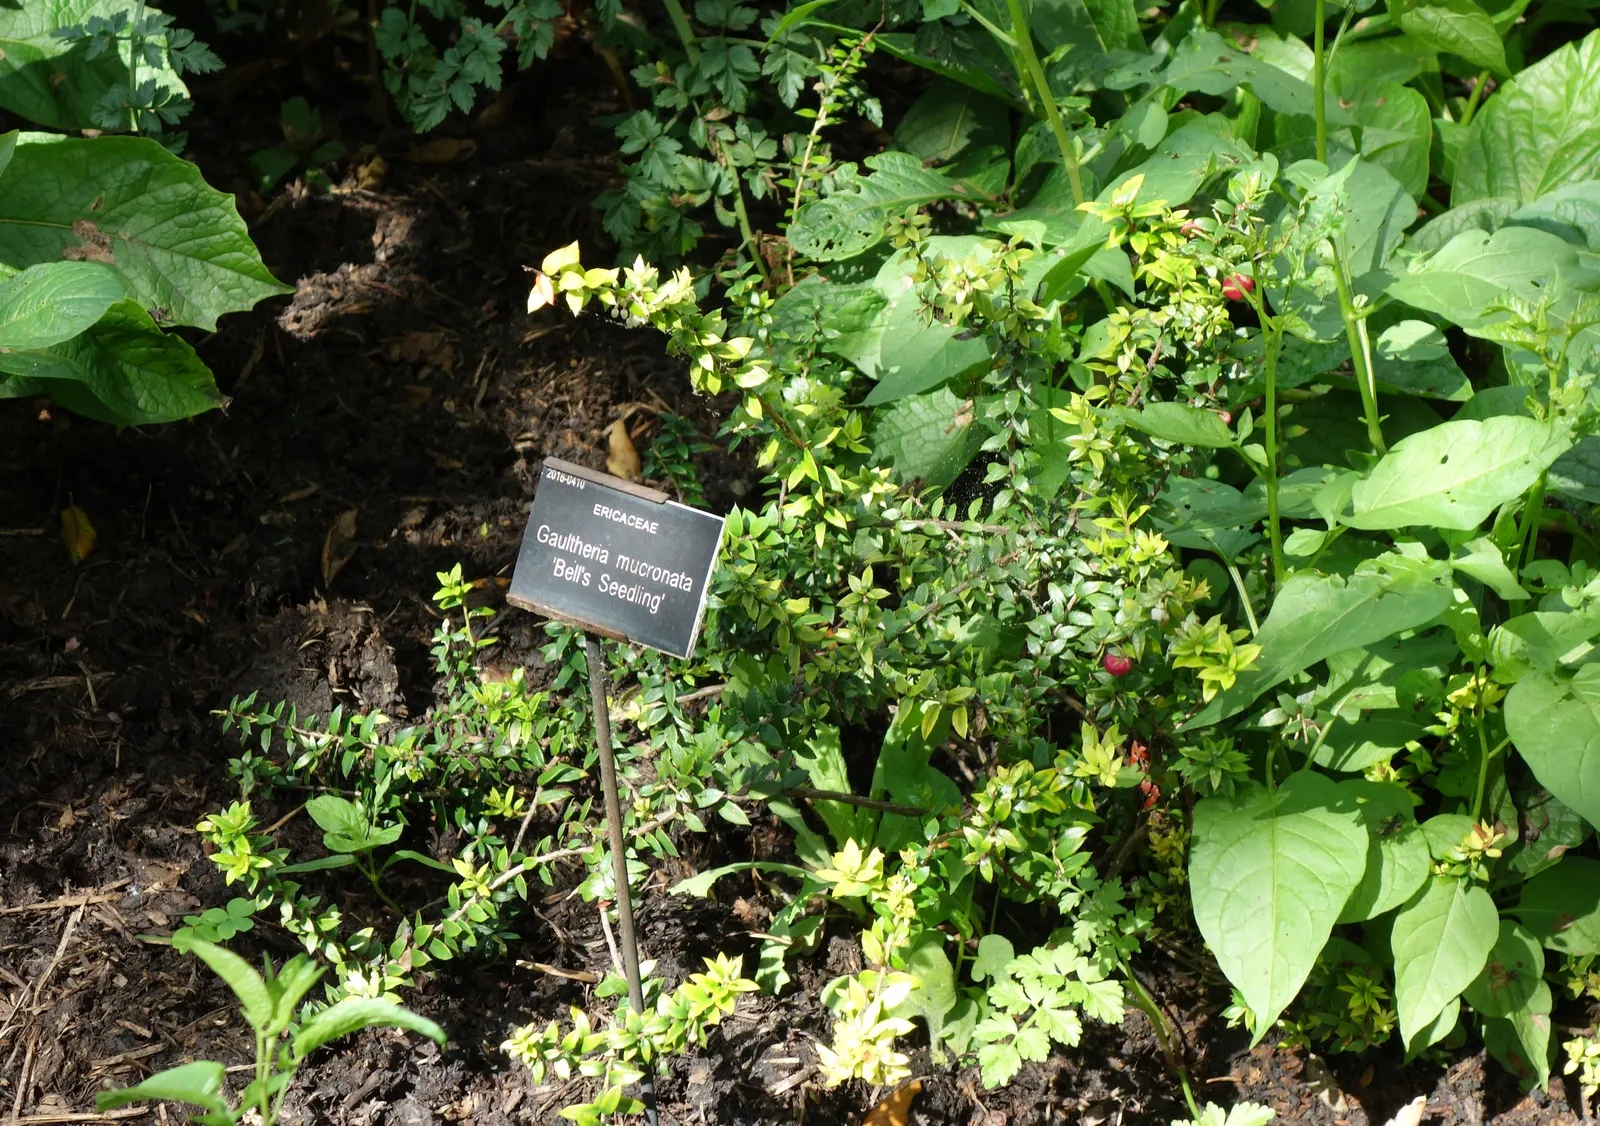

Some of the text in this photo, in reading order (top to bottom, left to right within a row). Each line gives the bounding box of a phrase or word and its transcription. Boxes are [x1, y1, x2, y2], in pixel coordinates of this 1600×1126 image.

[593, 503, 659, 534] ERICACEAE
[536, 525, 693, 592] Gaultheria mucronata
[552, 557, 666, 614] 'Bell's Seedling'
